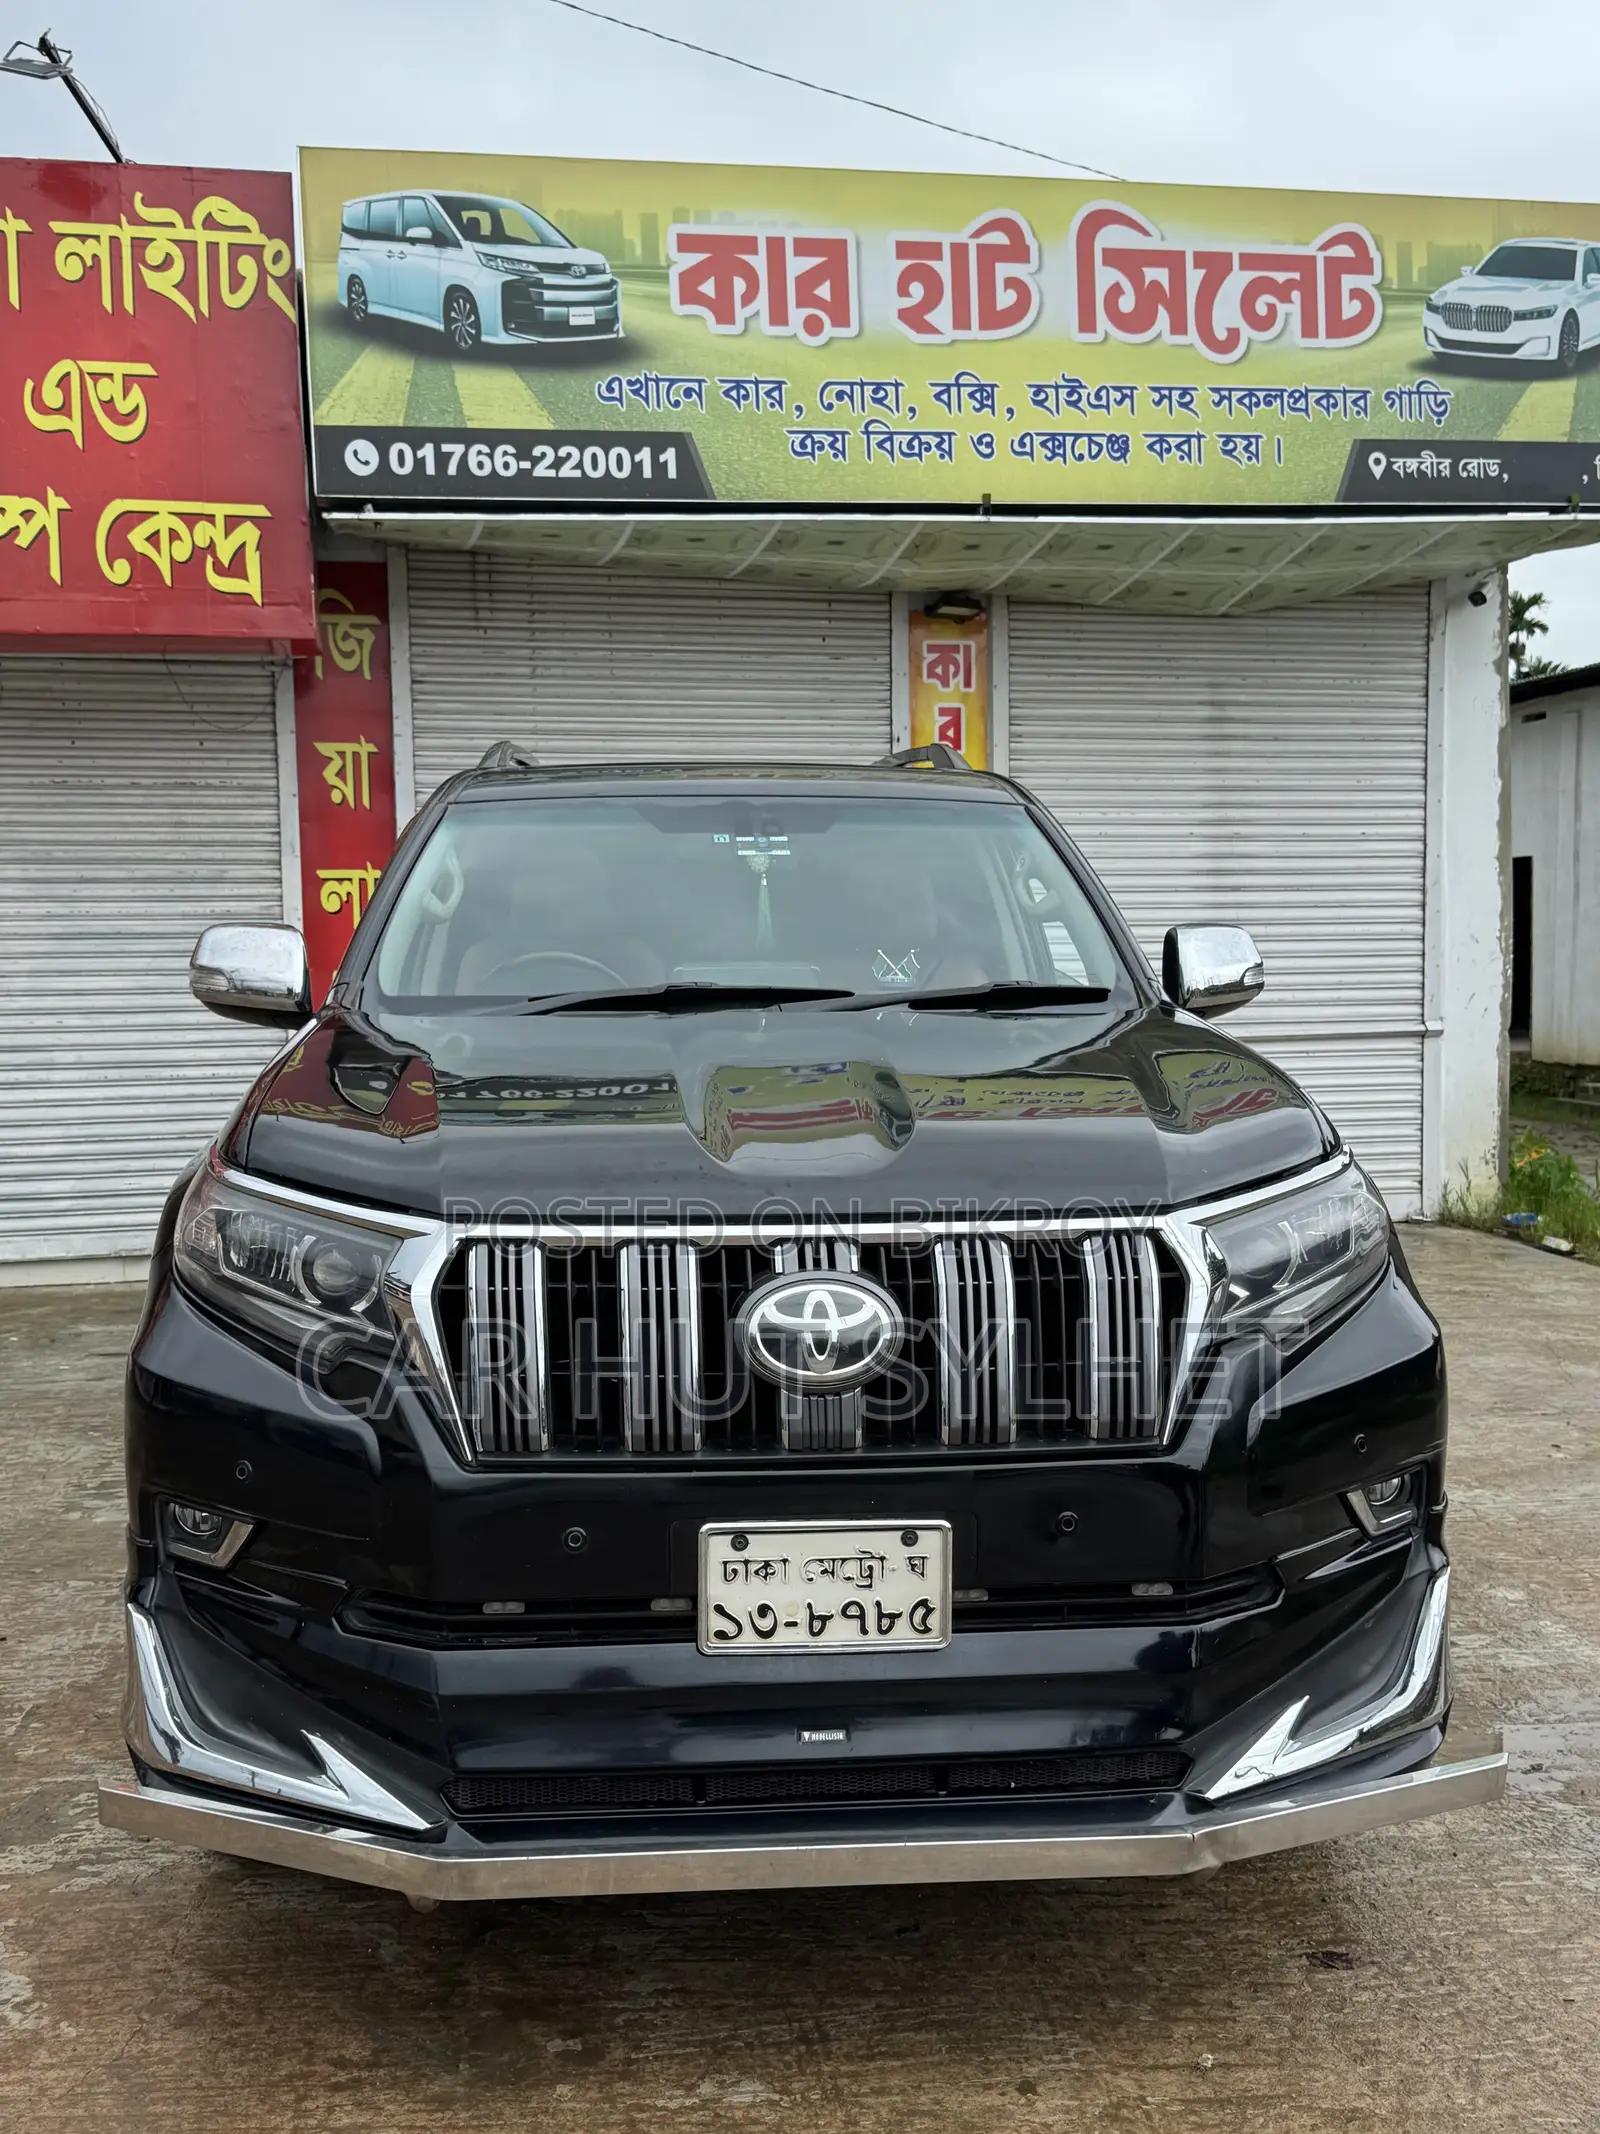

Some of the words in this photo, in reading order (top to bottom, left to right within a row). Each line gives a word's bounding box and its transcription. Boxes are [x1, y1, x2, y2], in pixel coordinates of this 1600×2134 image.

[49, 191, 297, 324] লাইটিং
[674, 230, 853, 340] কার
[893, 214, 1035, 338] হাট
[1075, 206, 1379, 357] সিলেট
[24, 358, 158, 451] এন্ড
[596, 371, 709, 412] এখানে
[1025, 372, 1140, 419] হাইএস
[1147, 384, 1201, 420] সহ
[1207, 382, 1372, 422] সকলপ্রকার
[1382, 377, 1455, 428] গাড়ি
[388, 441, 679, 481] 01766-220011
[784, 427, 852, 464] ক্রয়
[859, 418, 959, 464] বিক্রয়
[968, 430, 996, 462] ও
[1010, 430, 1131, 466] এক্সচেঞ্জ
[1141, 430, 1207, 466] করা
[1389, 450, 1453, 479] বঙ্গবীর
[96, 497, 273, 607] কেন্দ্র
[719, 1552, 791, 1584] ঢাকা
[712, 1596, 937, 1641] ১৩-৮৭৮৫
